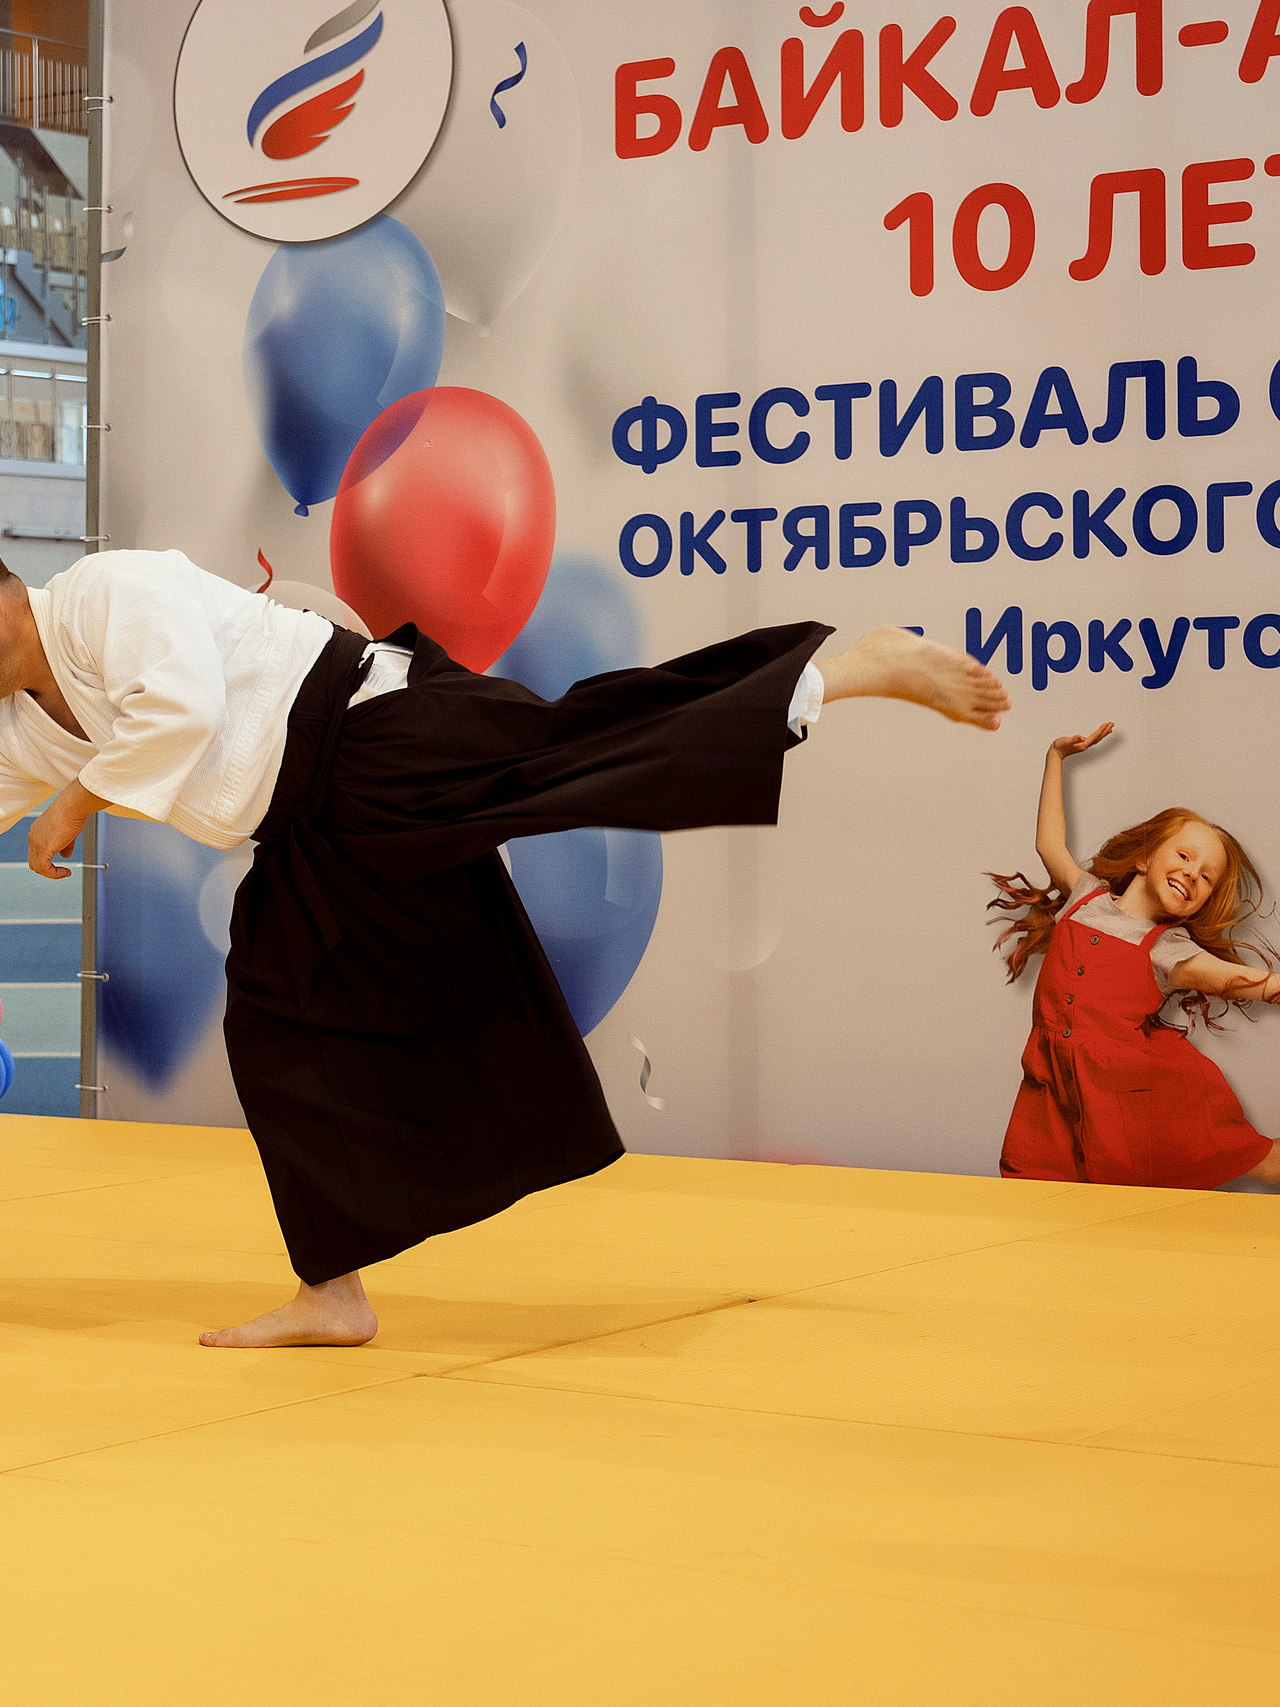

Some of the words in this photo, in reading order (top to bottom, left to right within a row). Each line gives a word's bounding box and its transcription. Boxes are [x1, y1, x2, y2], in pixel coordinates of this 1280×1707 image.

[883, 182, 1036, 297] 10
[1068, 154, 1280, 282] ЛЕ
[611, 356, 1240, 475] ФЕСТИВАЛЬ
